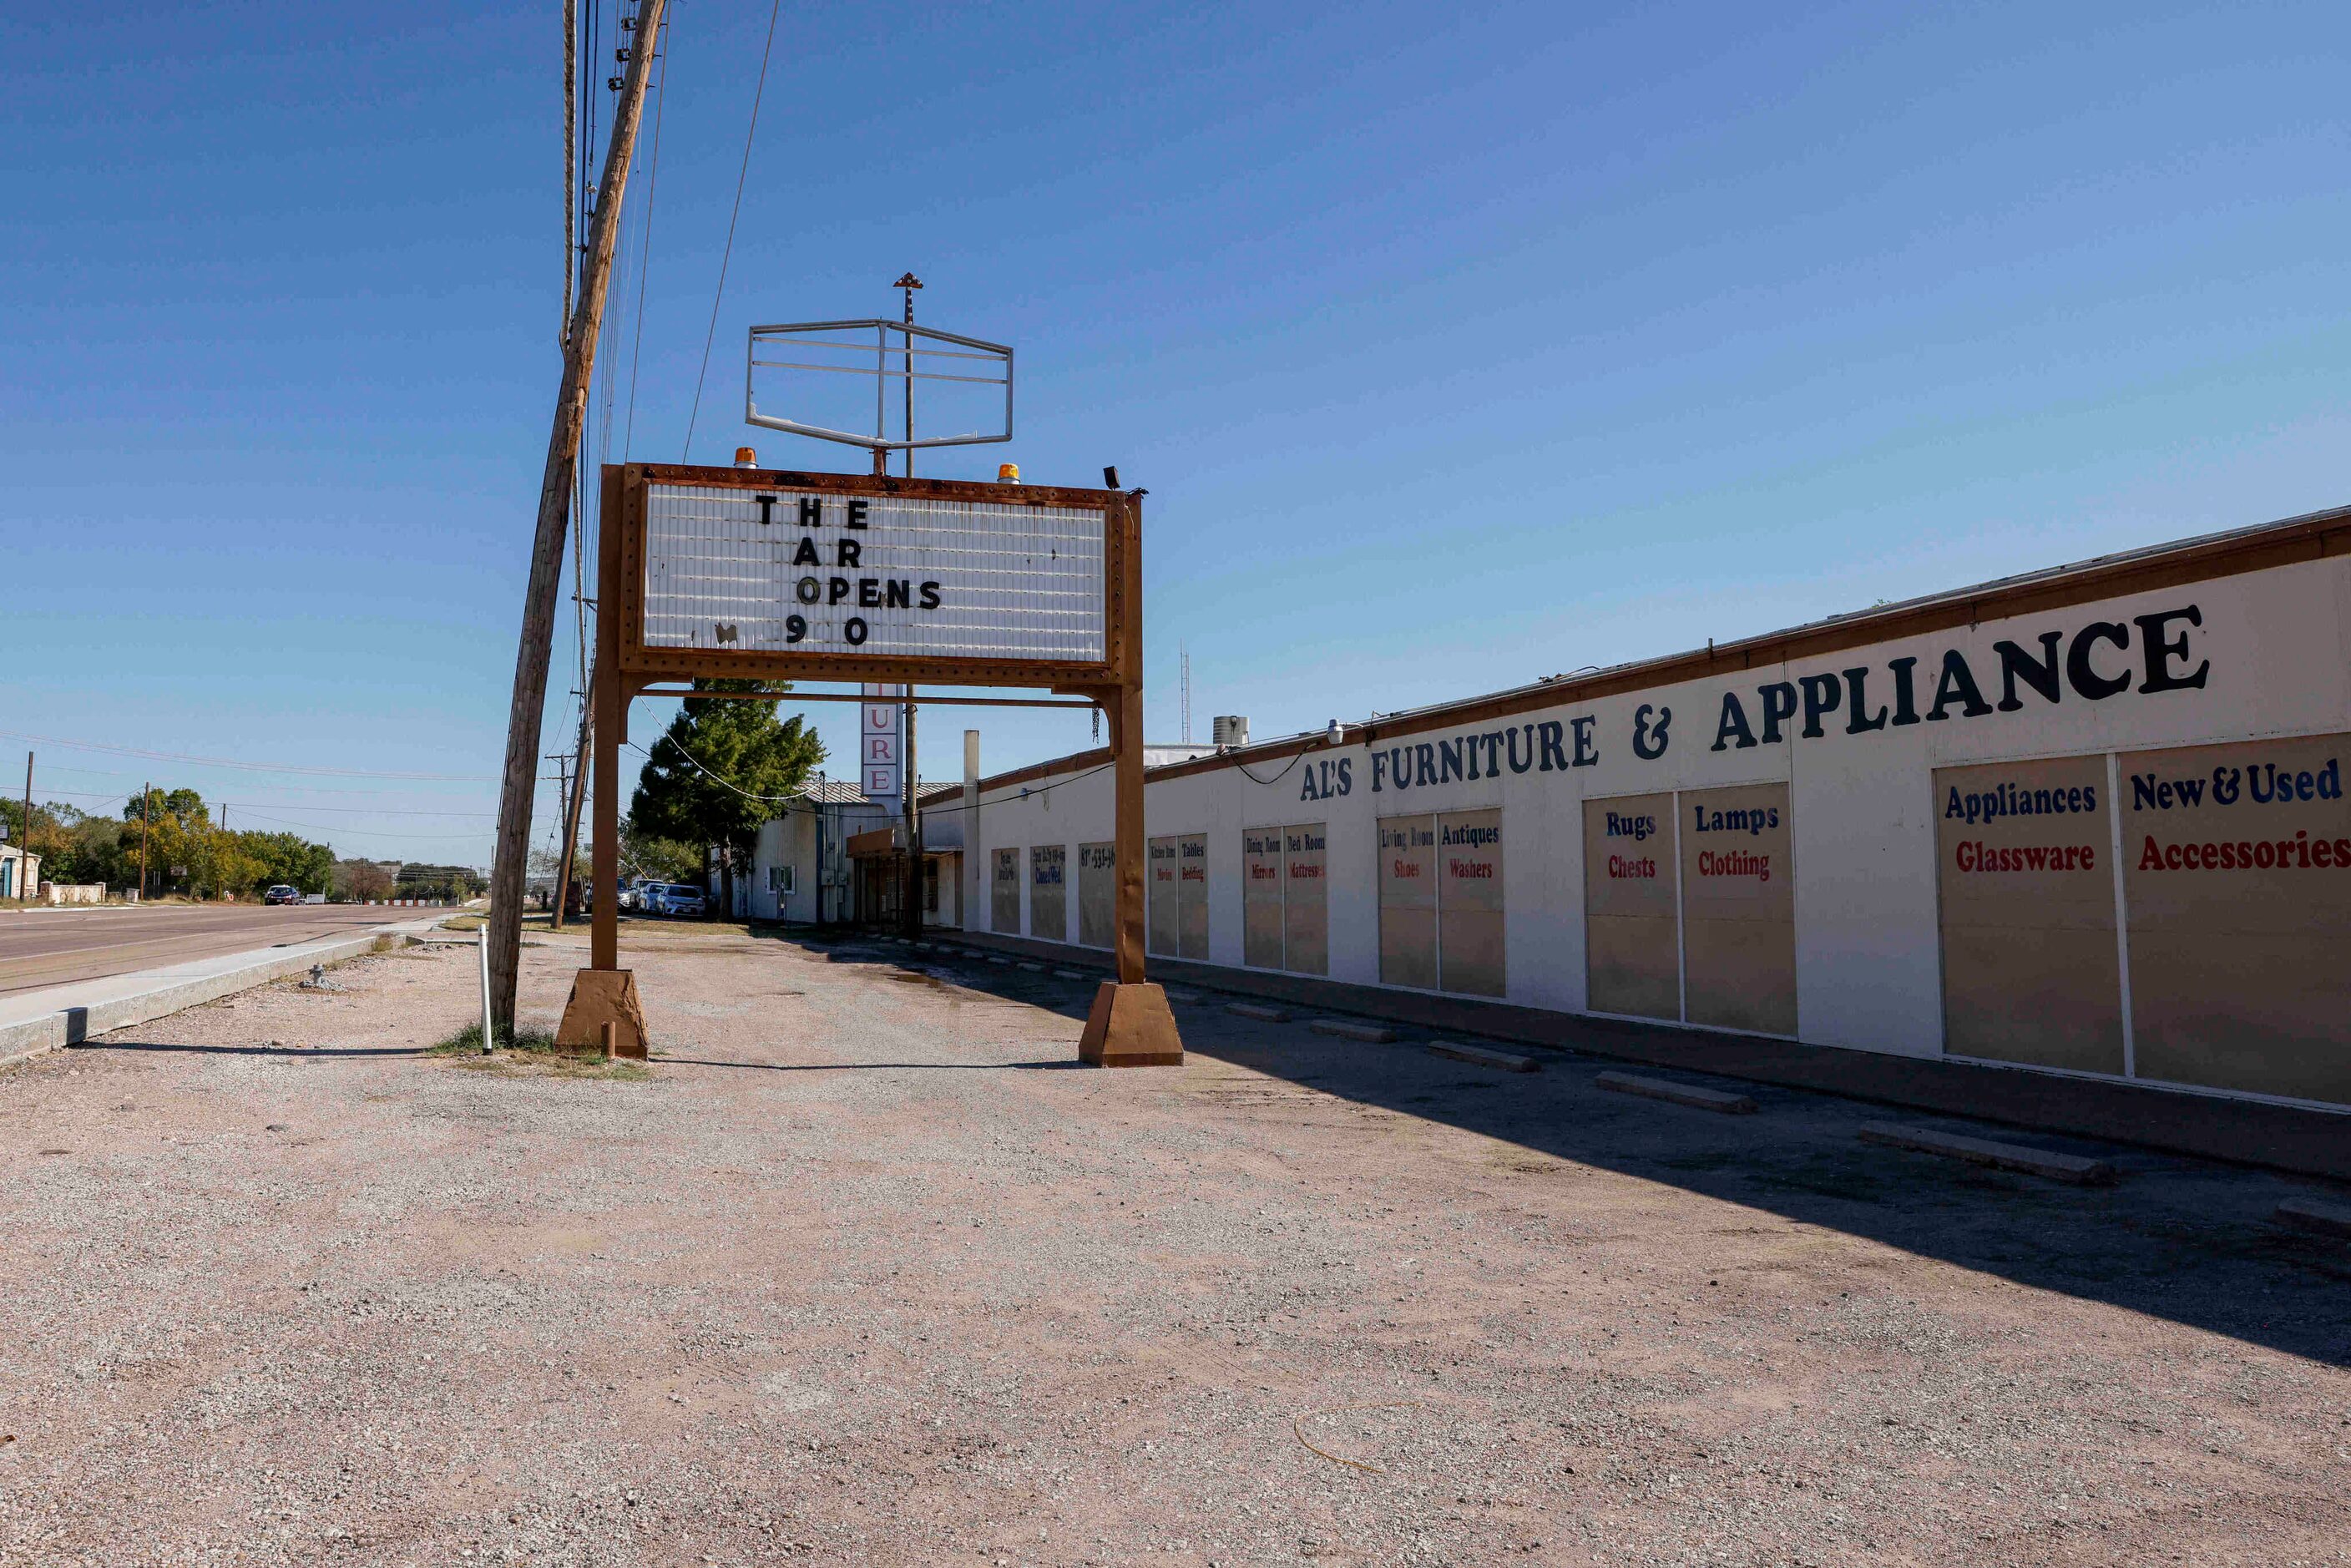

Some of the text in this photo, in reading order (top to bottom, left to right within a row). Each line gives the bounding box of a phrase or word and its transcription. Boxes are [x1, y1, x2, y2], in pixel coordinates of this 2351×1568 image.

[756, 495, 868, 529] THE
[793, 537, 861, 568] AR
[796, 576, 940, 609] OPENS
[1300, 604, 2210, 802] AL'S FURNITURE & APPLIANCE
[2130, 758, 2343, 812] New & Used
[1944, 782, 2096, 825] Appliances
[1442, 823, 1499, 848] Antiques
[1605, 812, 1656, 842] Rugs
[1695, 805, 1778, 836] Lamps
[1182, 842, 1204, 857] Tables
[1287, 834, 1325, 852] Bed Room
[1382, 827, 1433, 851] Living Room
[2137, 830, 2351, 871] Accessories
[1251, 863, 1276, 879] Mirrors
[1394, 859, 1420, 878] Shoes
[1450, 858, 1493, 878] Washers
[1609, 854, 1656, 878] Chests
[1698, 849, 1770, 882] Clothing
[1955, 841, 2095, 873] Glassware
[1182, 867, 1204, 883] Bedding
